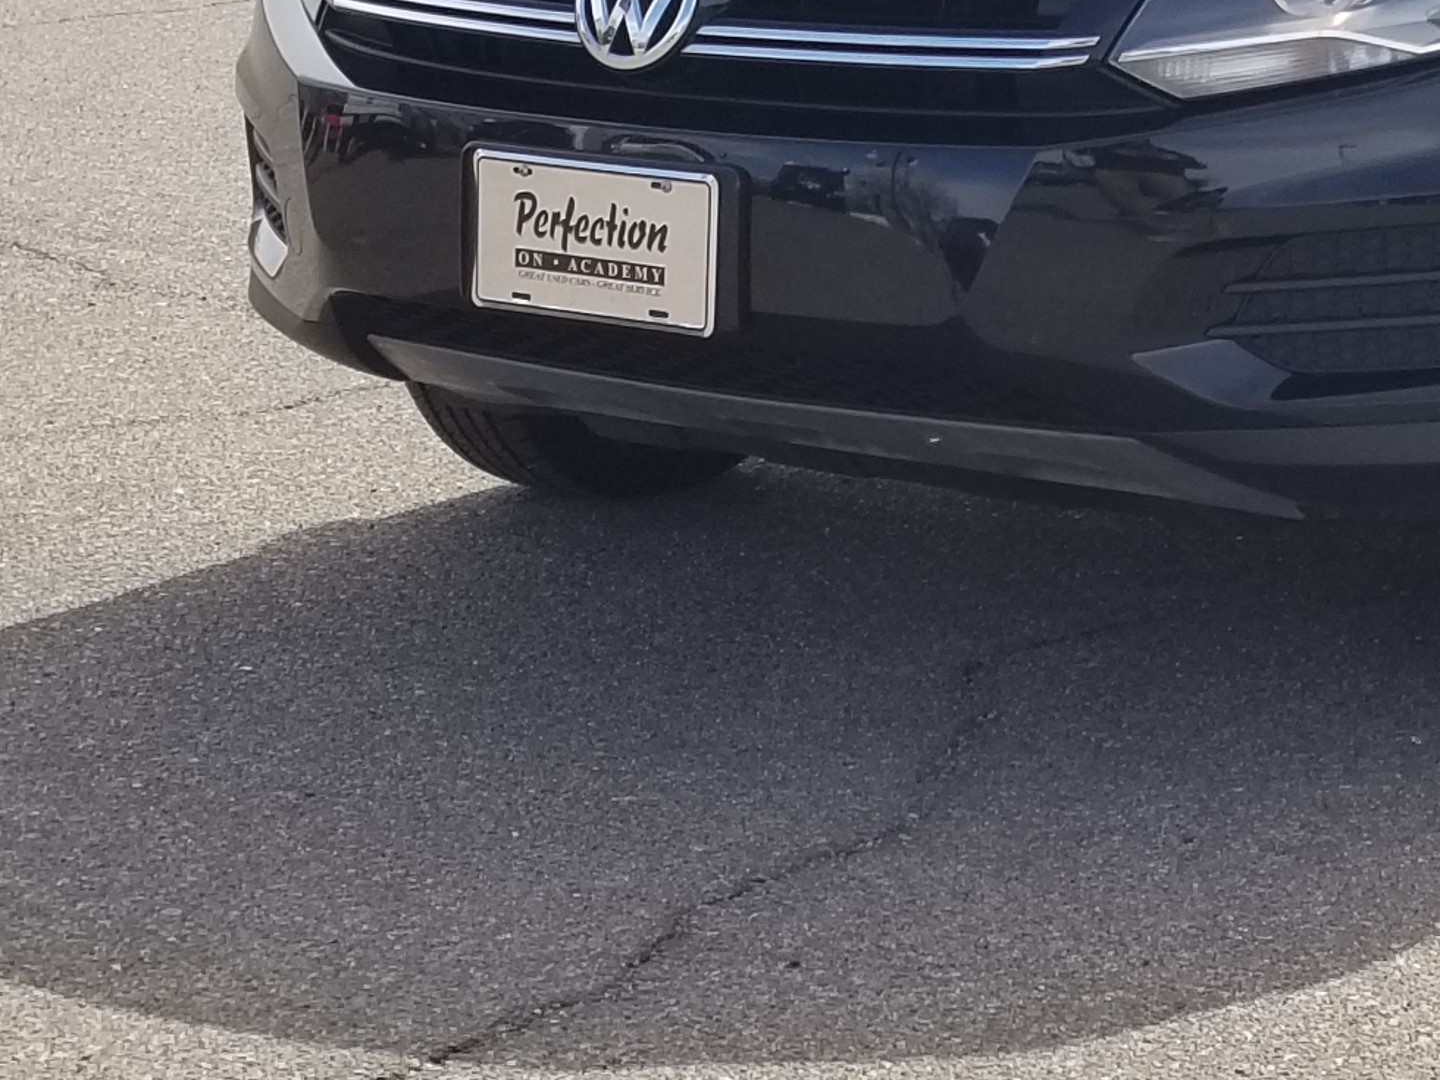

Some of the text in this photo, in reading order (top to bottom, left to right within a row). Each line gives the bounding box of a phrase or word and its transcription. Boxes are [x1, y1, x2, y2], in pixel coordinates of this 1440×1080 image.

[513, 191, 669, 253] Perfection
[518, 251, 664, 283] ON ACADEMY
